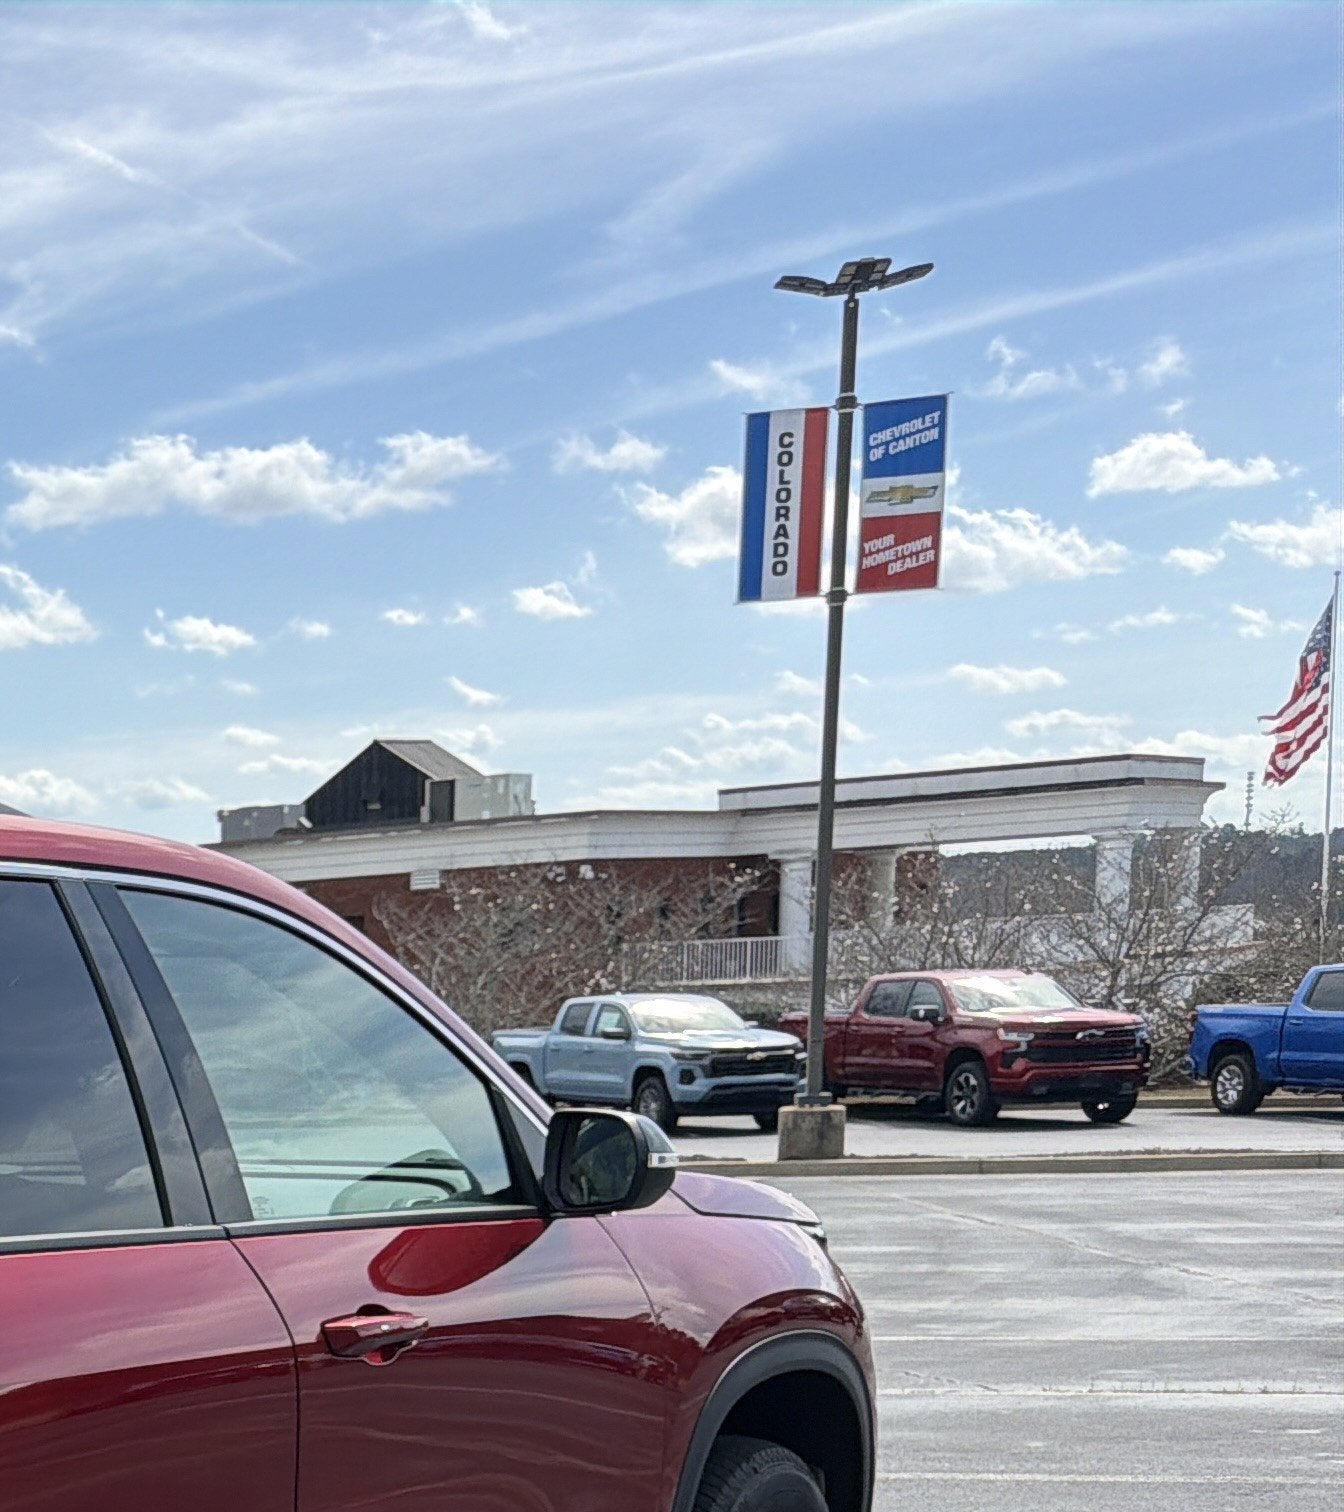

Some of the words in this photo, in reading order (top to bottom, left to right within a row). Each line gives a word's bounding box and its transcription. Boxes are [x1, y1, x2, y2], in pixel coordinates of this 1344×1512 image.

[869, 410, 941, 447] CHEVROLET
[869, 445, 886, 462] OF
[888, 427, 940, 455] CANTON
[771, 431, 795, 577] COLORADO
[861, 534, 933, 570] HOMETOWN
[863, 533, 896, 555] YOUR
[886, 549, 936, 576] DEALER
